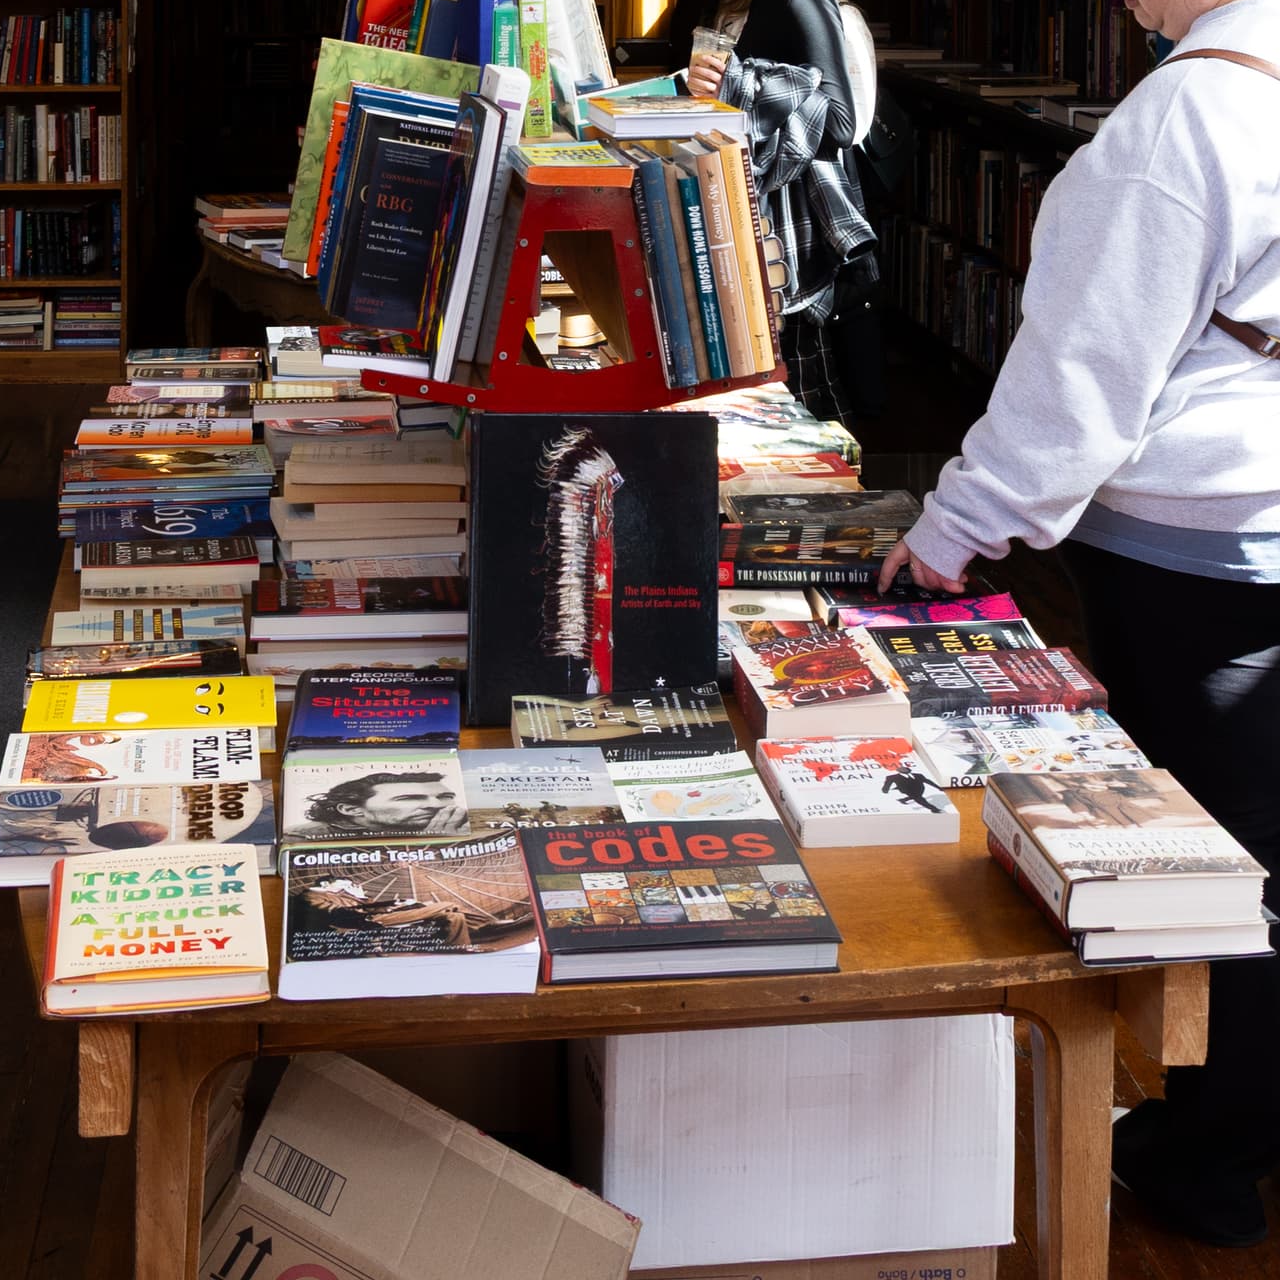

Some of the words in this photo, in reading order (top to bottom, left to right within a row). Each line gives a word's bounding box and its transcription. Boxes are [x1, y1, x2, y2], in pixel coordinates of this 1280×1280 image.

[497, 25, 512, 58] Healing
[708, 183, 719, 198] My
[377, 193, 414, 213] RBG
[688, 205, 701, 226] DOWN
[710, 199, 725, 240] Journey
[692, 227, 706, 252] HOME
[695, 252, 713, 294] MISSOURI
[737, 570, 754, 581] THE
[757, 570, 808, 581] POSSESSION
[811, 571, 821, 581] OF
[825, 571, 846, 582] ALBA
[849, 569, 868, 583] DÍAZ
[624, 585, 638, 596] The
[641, 585, 666, 596] Plains
[668, 585, 698, 596] Indians
[621, 600, 643, 608] Artists
[645, 600, 652, 608] of
[654, 600, 672, 608] Earth
[674, 600, 687, 608] and
[689, 600, 700, 608] Sky
[758, 635, 829, 653] SARAH
[772, 640, 841, 659] MAAS
[788, 674, 871, 695] CRESCENT
[922, 662, 973, 689] GREAT
[352, 687, 411, 697] The
[792, 680, 876, 703] CITY
[311, 697, 449, 707] Situation
[332, 708, 426, 718] Room
[572, 707, 597, 729] SEX
[603, 710, 627, 726] AT
[633, 698, 663, 735] DAWN
[226, 728, 253, 764] FLIM-
[192, 735, 220, 780] FLAM!
[817, 760, 917, 773] ECONOMIC
[477, 764, 518, 774] THE
[527, 765, 590, 774] DUEL
[791, 775, 822, 783] HIT
[829, 773, 874, 782] MAN
[950, 775, 984, 788] ROA
[218, 782, 250, 820] HOOP
[804, 803, 848, 811] JOHN
[188, 783, 216, 841] DREAMS
[807, 807, 881, 816] PERKINS
[487, 821, 556, 829] TARIQ
[547, 830, 577, 840] the
[584, 828, 628, 838] book
[633, 826, 653, 837] of
[293, 850, 381, 866] Collected
[386, 848, 435, 862] Tesla
[440, 834, 517, 859] Writings
[544, 825, 777, 867] codes
[1068, 839, 1216, 849] MADELEINE
[73, 861, 246, 886] TRACY
[70, 880, 246, 904] KIDDER
[70, 913, 98, 925] A
[111, 904, 245, 925] TRUCK
[93, 924, 197, 941] FULL
[83, 936, 233, 957] MONEY
